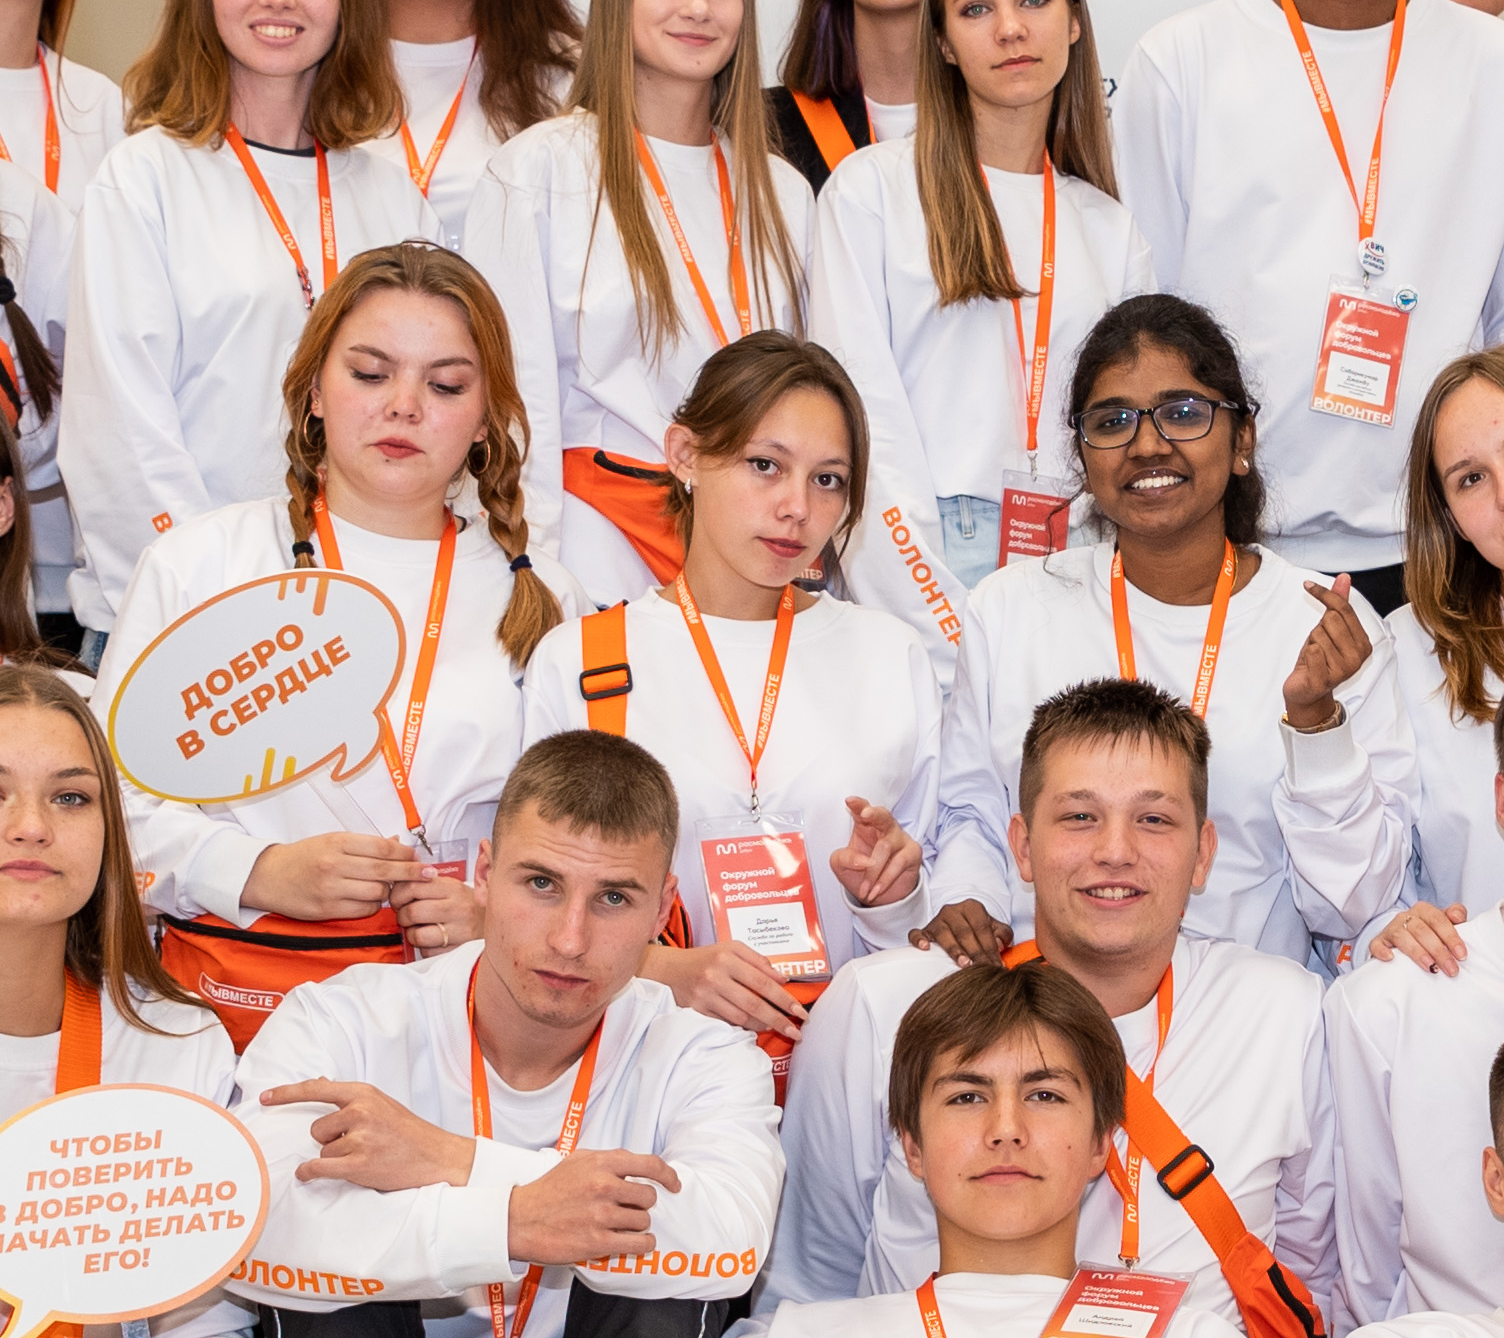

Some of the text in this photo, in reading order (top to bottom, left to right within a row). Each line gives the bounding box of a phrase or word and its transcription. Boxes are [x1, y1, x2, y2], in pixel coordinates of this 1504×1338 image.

[1304, 50, 1331, 113] #МЫВМЕСТЕ
[1365, 157, 1380, 226] #МЫВМЕСТЕ
[1031, 346, 1047, 419] #МЫВМЕСТЕ
[1313, 396, 1392, 425] ВОЛОНТЕР
[179, 622, 305, 721] ДОБРО
[1194, 644, 1217, 717] МЫВМЕСТЕ
[176, 635, 353, 763] В СЕРДЦЕ
[757, 672, 780, 749] #МЫВМЕСТЕ
[403, 700, 424, 774] ЫВМЕСТЕ
[719, 866, 776, 880] Окружной
[721, 879, 758, 893] форум
[49, 1129, 164, 1162] ЧТОБЫ
[559, 1101, 584, 1157] ВМЕСТЕ
[25, 1156, 195, 1193] ПОВЕРИТЬ
[13, 1191, 141, 1227] ДОБРО,
[145, 1178, 239, 1212] НАДО
[118, 1207, 247, 1245] ДЕЛАТЬ
[82, 1246, 152, 1276] ЕГО!
[229, 1259, 385, 1297] ОЛОНТЕР
[576, 1247, 757, 1279] ВОЛОНТЕ
